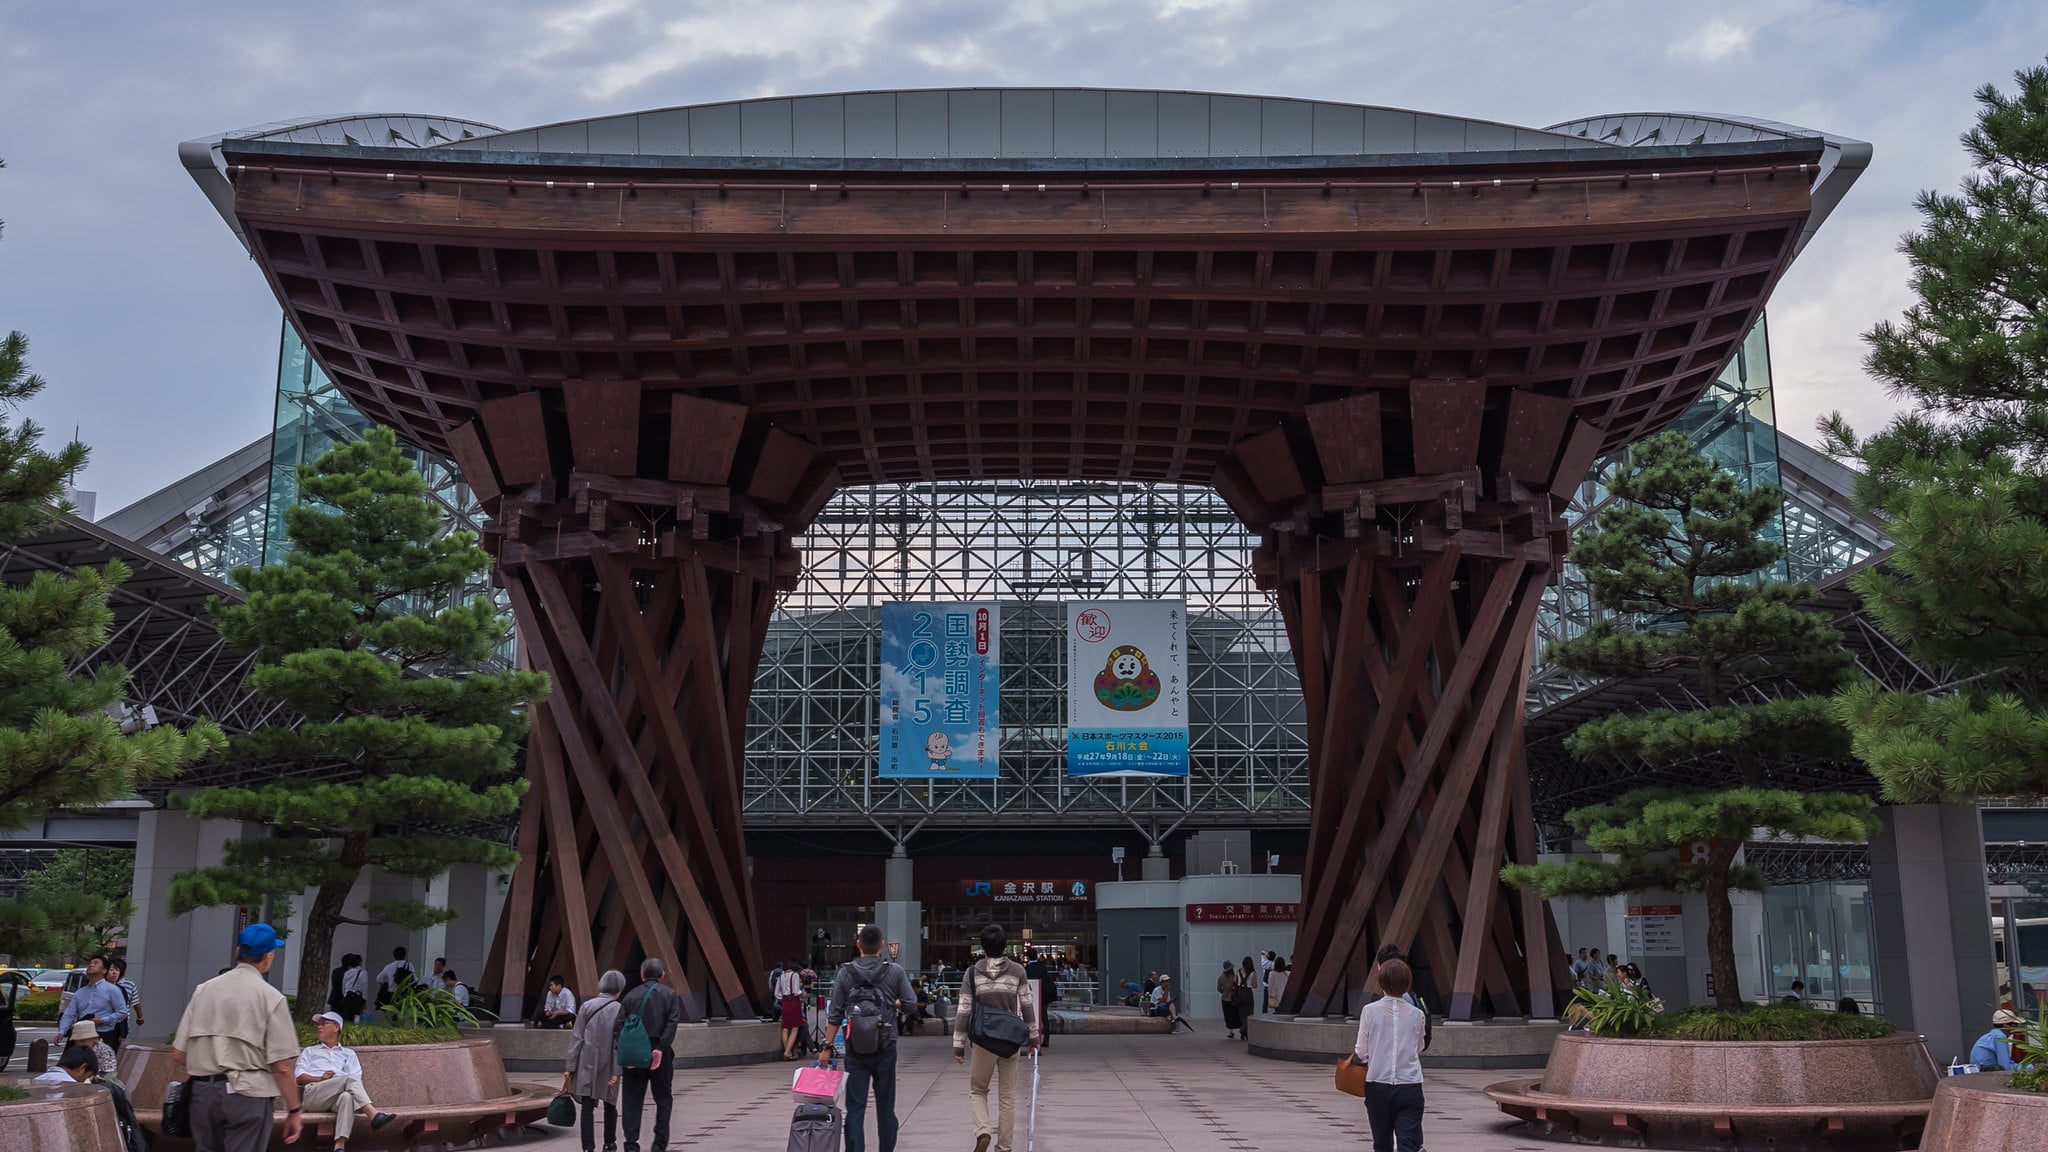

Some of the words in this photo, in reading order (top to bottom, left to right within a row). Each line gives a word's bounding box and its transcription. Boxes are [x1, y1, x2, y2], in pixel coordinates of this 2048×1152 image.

[978, 612, 987, 651] 10月1日
[943, 612, 970, 725] 国勢調査
[1082, 731, 1184, 741] 日本スポーツマスターズ2015
[1105, 741, 1149, 751] 石川大会
[965, 881, 992, 897] JR
[1004, 882, 1054, 894] 金沢駅
